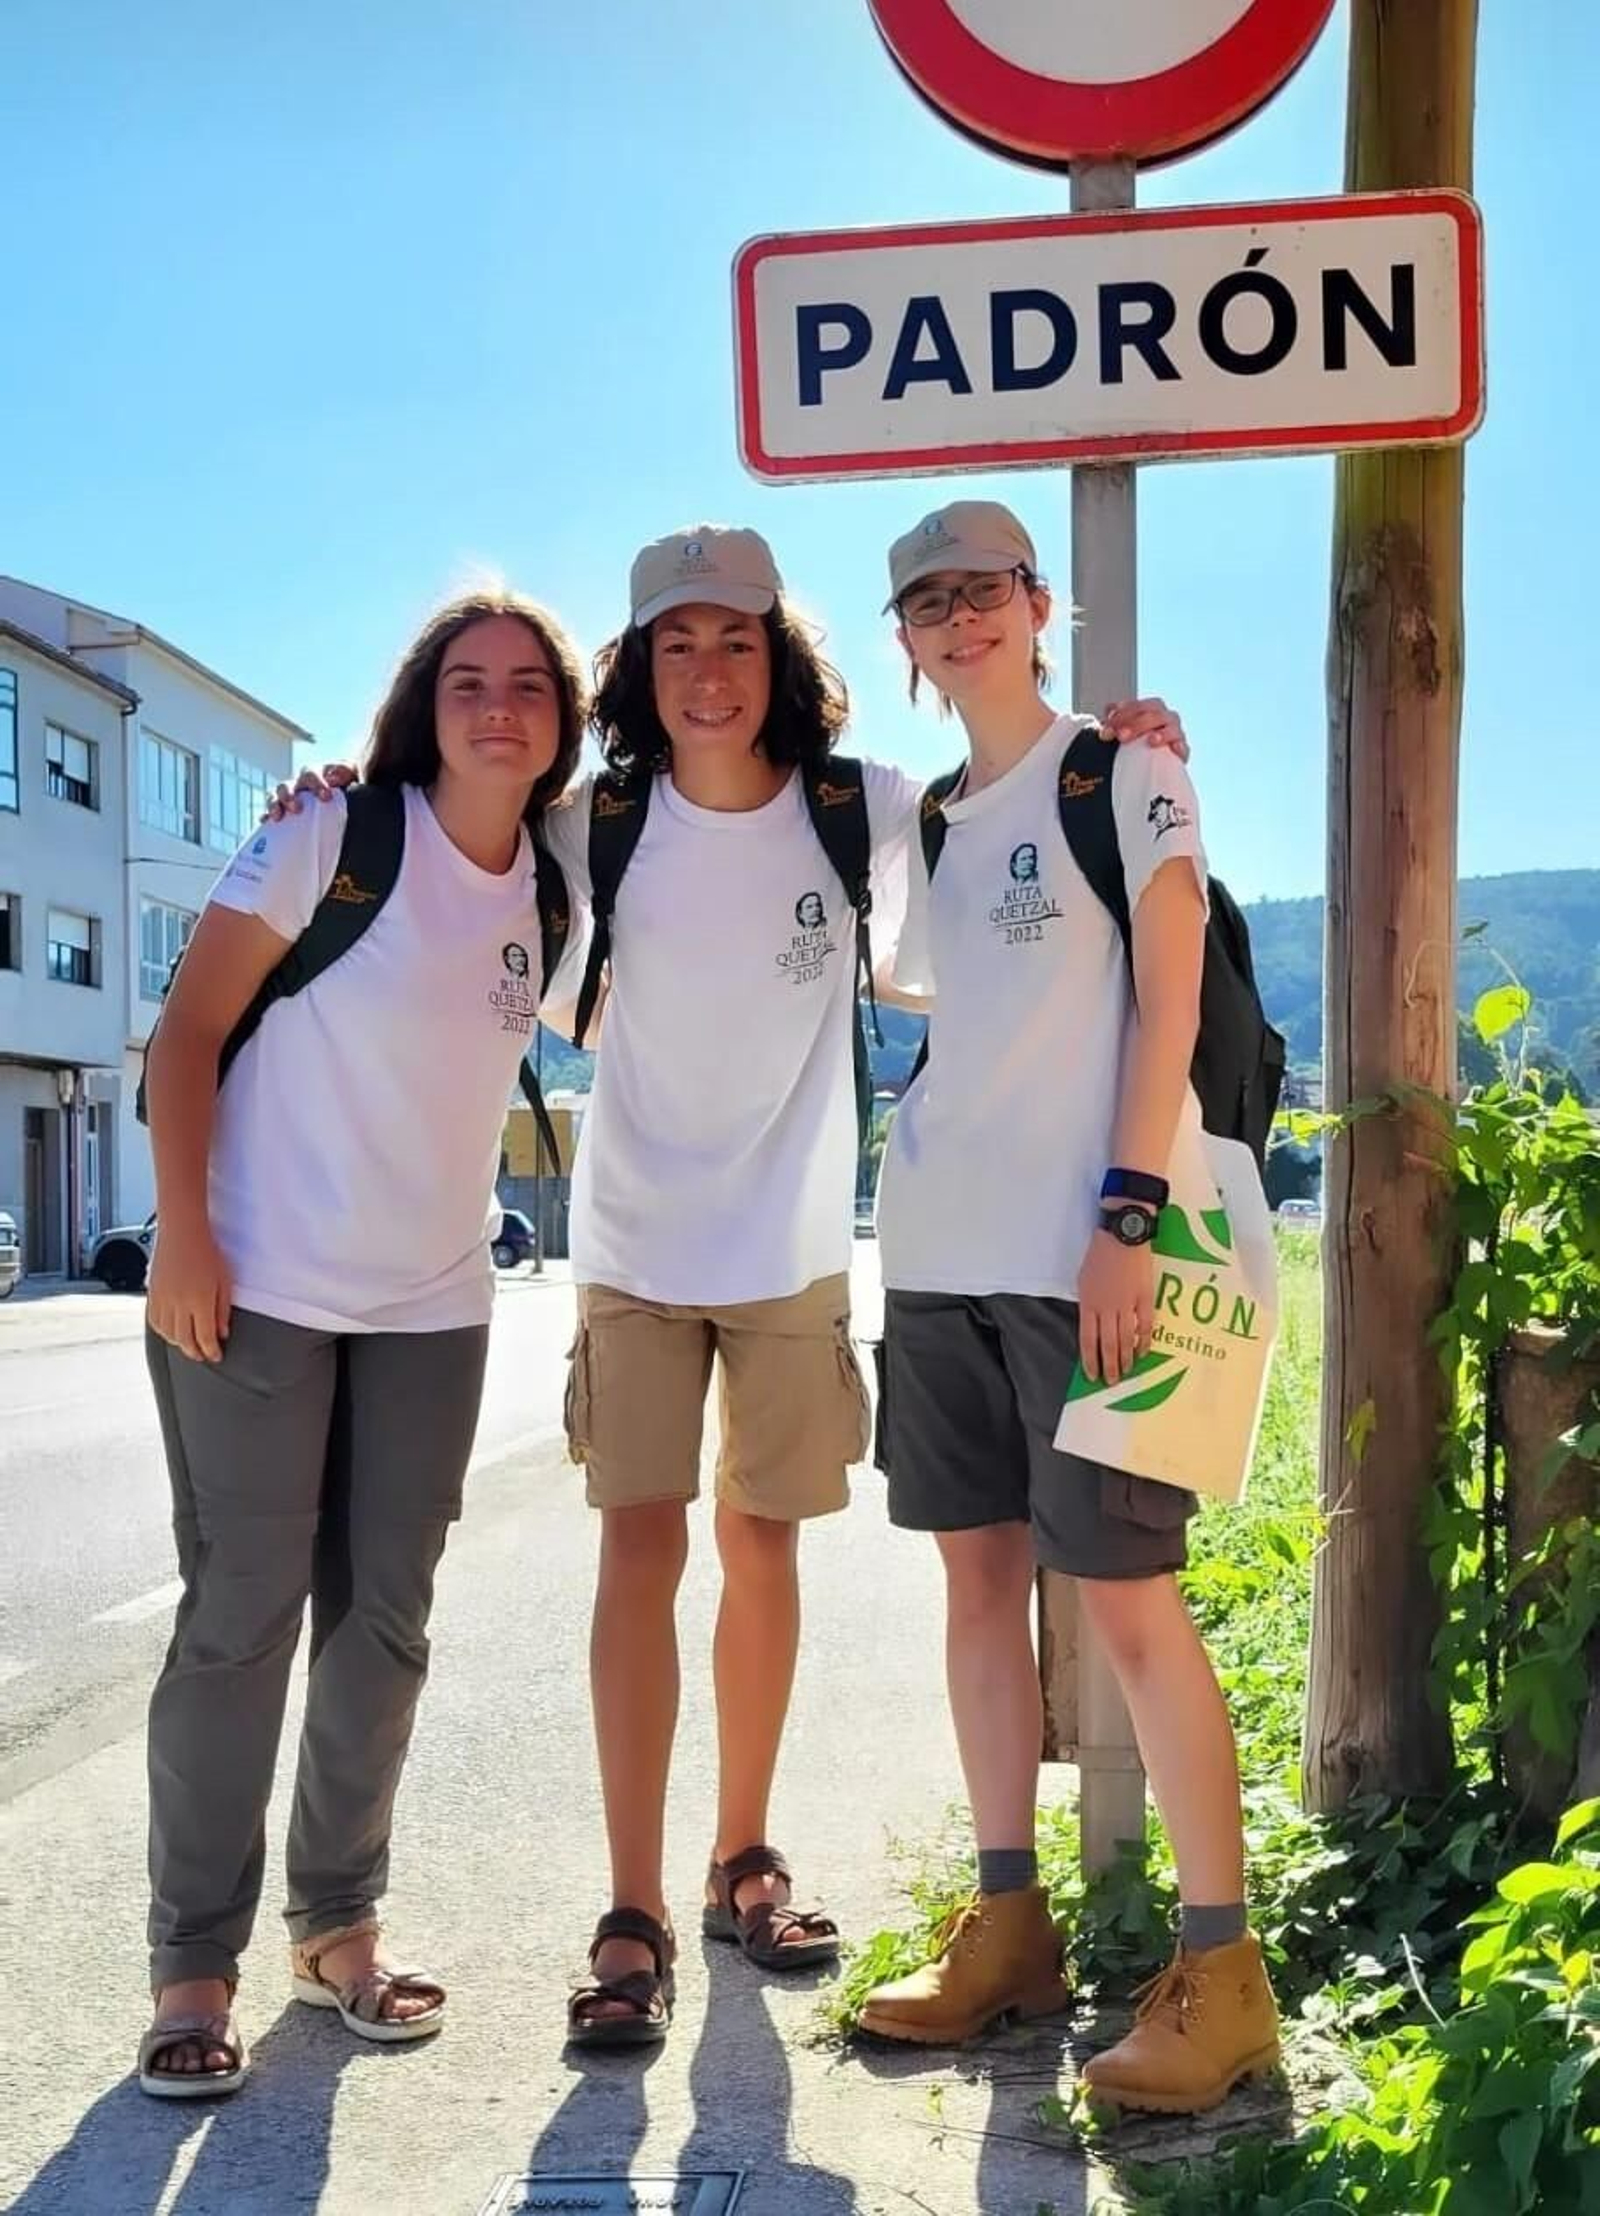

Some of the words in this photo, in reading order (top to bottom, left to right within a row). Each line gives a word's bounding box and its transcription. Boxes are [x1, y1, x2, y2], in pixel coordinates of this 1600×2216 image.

[796, 248, 1417, 407] PADRÓN
[1004, 885, 1042, 904] RUTA
[989, 898, 1062, 922] QUETZAL
[1005, 924, 1044, 944] 2022
[1154, 1271, 1257, 1338] RÓN
[1151, 1325, 1227, 1361] destino
